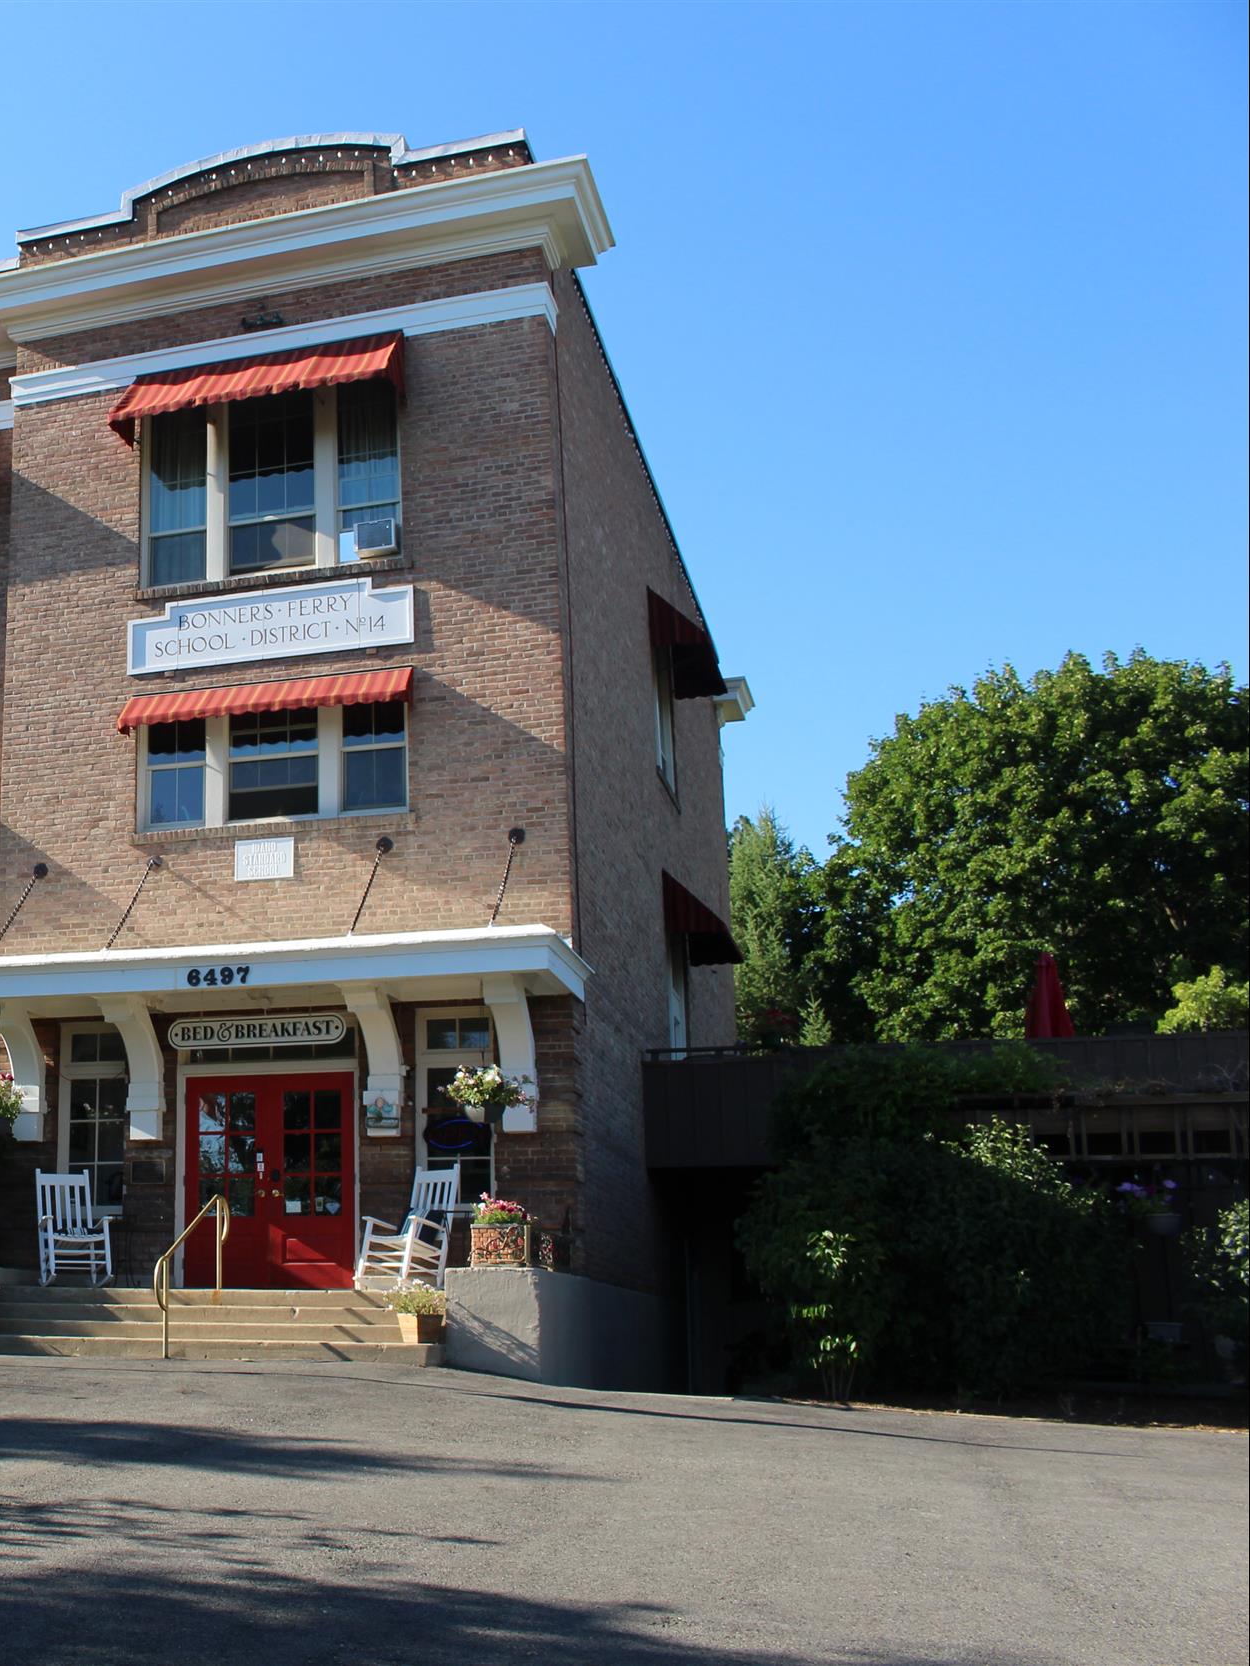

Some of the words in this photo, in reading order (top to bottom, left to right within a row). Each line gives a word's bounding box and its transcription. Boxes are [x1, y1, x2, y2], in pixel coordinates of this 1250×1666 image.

[178, 604, 274, 631] BONNERS
[287, 594, 354, 617] FERRY
[154, 630, 237, 658] SCHOOL
[250, 620, 330, 646] DISTRICT
[243, 851, 287, 866] STANDARD
[247, 864, 279, 877] SCHOOL
[187, 966, 250, 987] 6497
